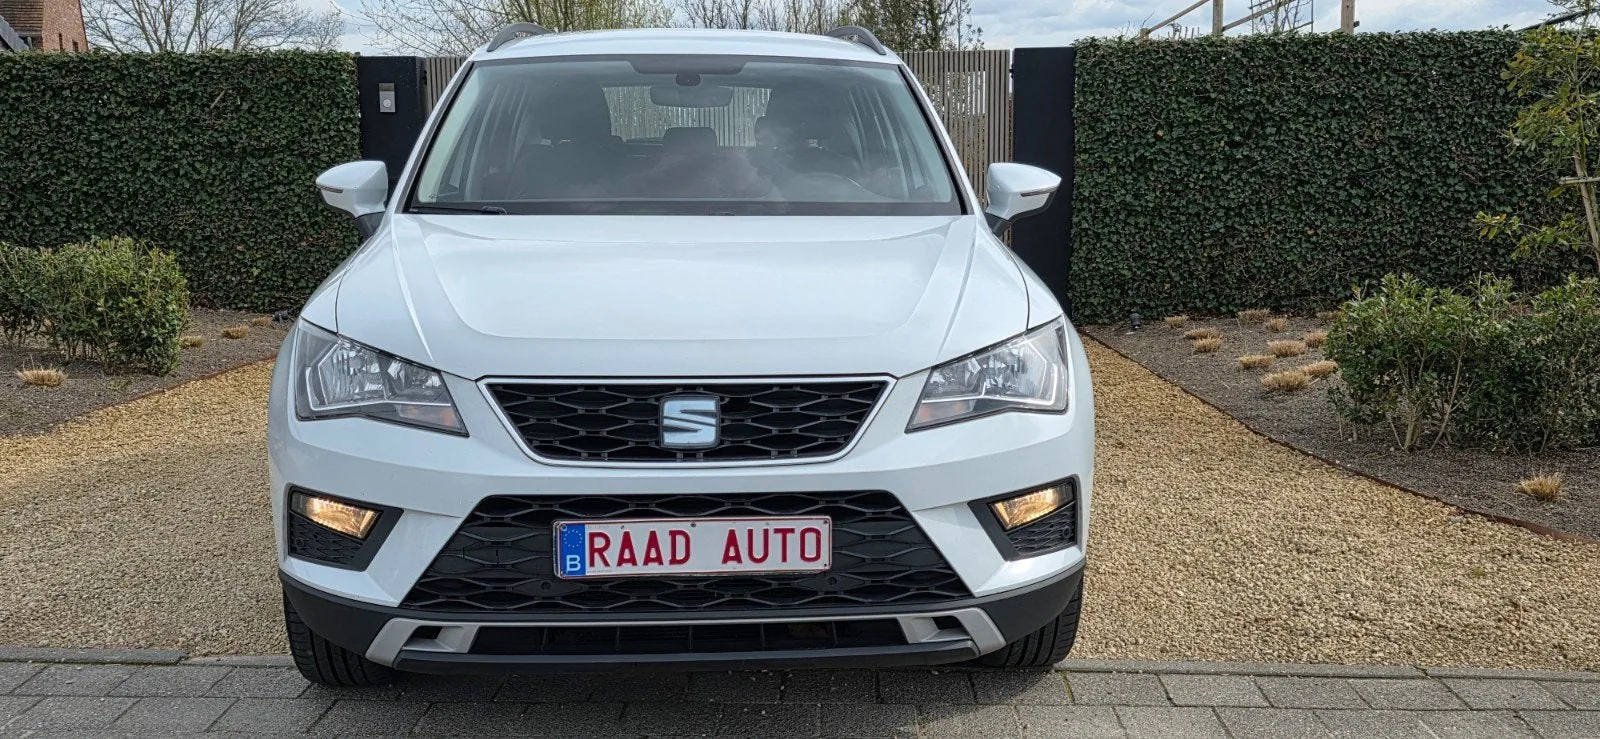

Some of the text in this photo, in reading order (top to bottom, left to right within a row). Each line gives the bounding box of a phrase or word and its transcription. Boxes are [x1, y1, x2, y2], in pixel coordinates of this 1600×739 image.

[588, 527, 822, 567] RAAD AUTO
[566, 555, 581, 571] B
